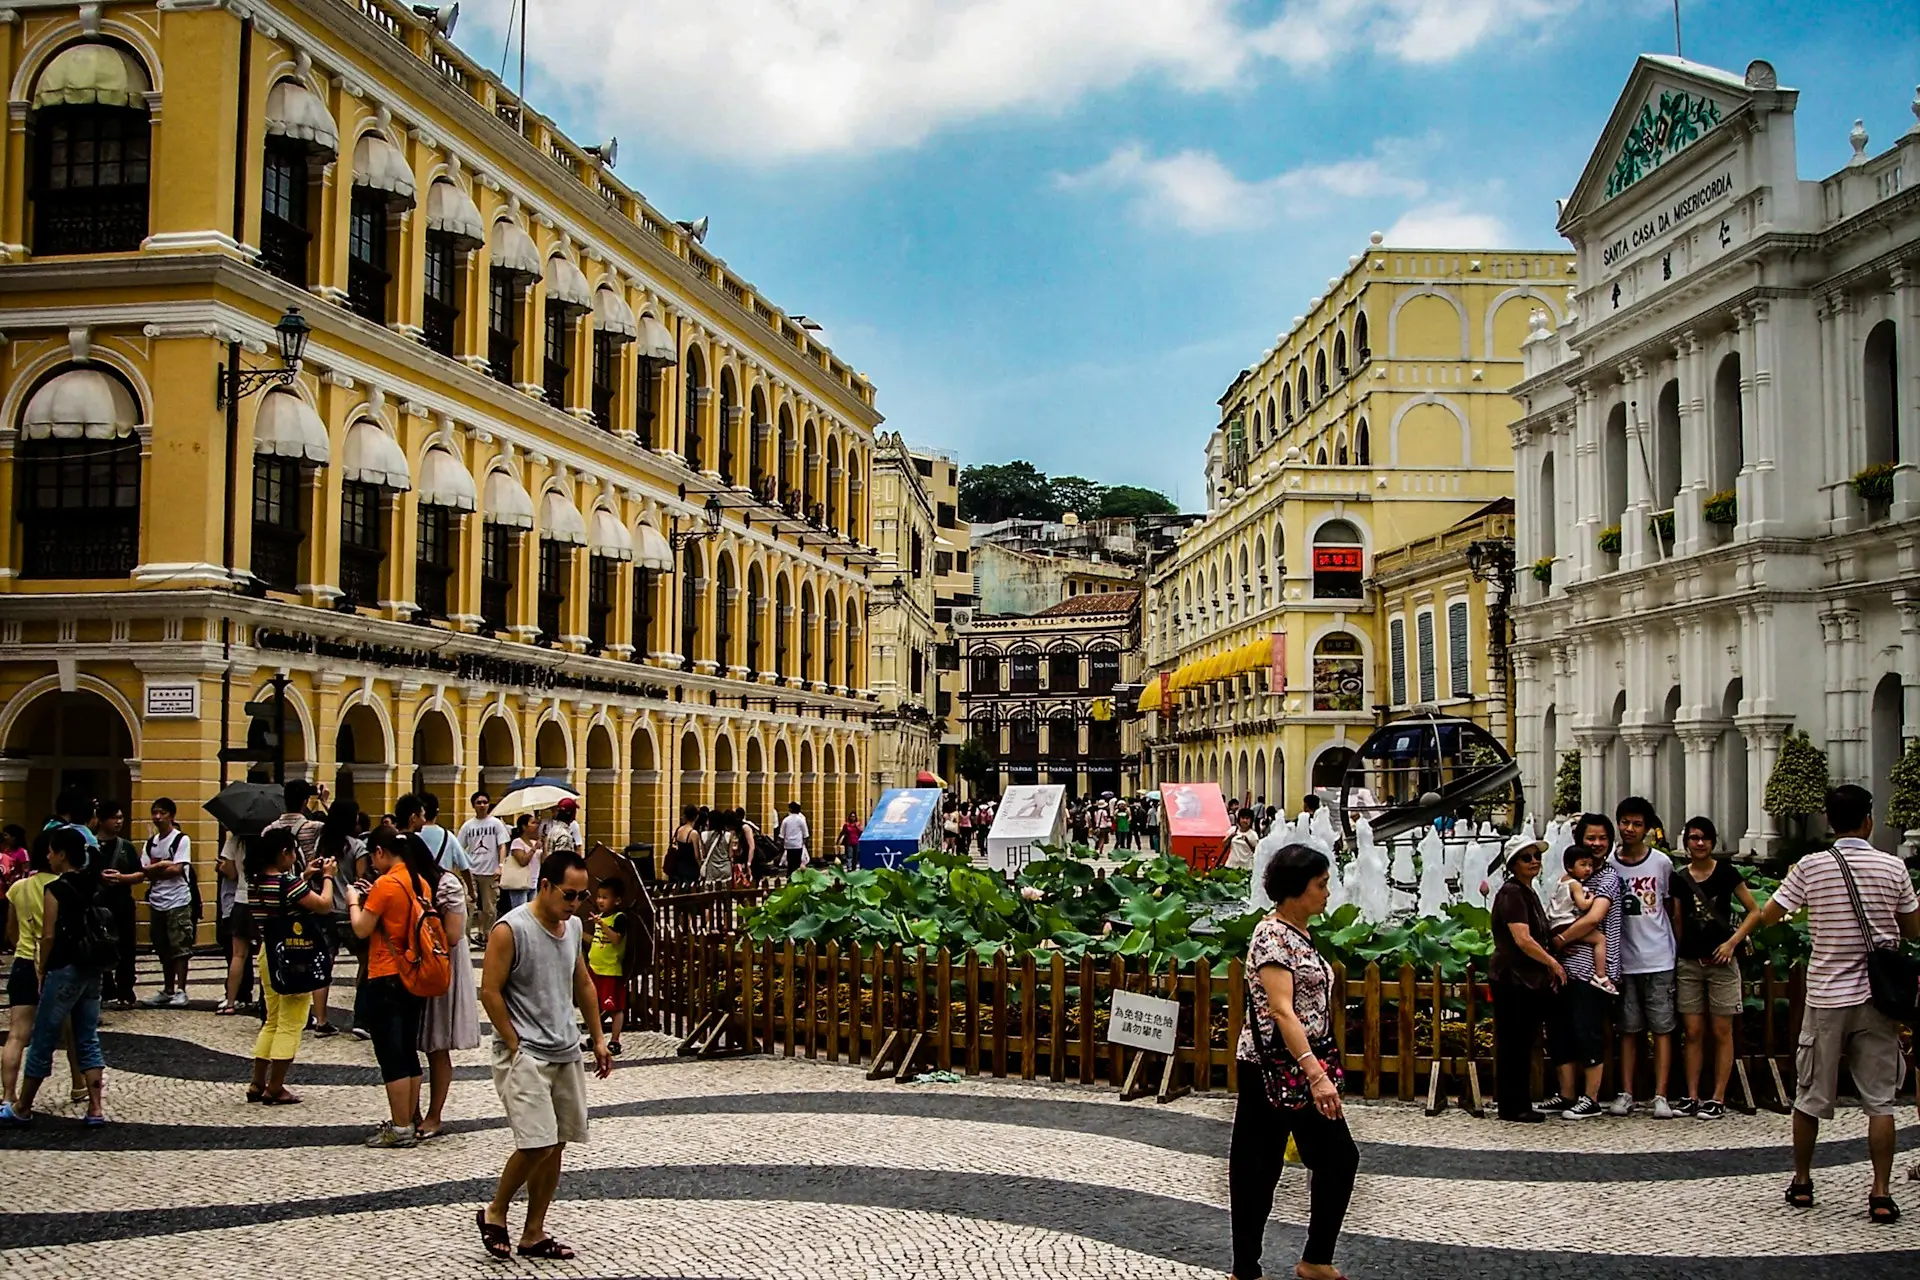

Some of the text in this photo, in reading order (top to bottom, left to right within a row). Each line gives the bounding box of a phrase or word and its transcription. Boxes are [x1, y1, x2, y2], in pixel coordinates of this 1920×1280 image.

[1604, 172, 1733, 266] SANTA CASA DA MISERICORDIA
[875, 846, 904, 872] 文
[1007, 845, 1031, 870] 明
[1115, 1006, 1173, 1028] 為免發生危險
